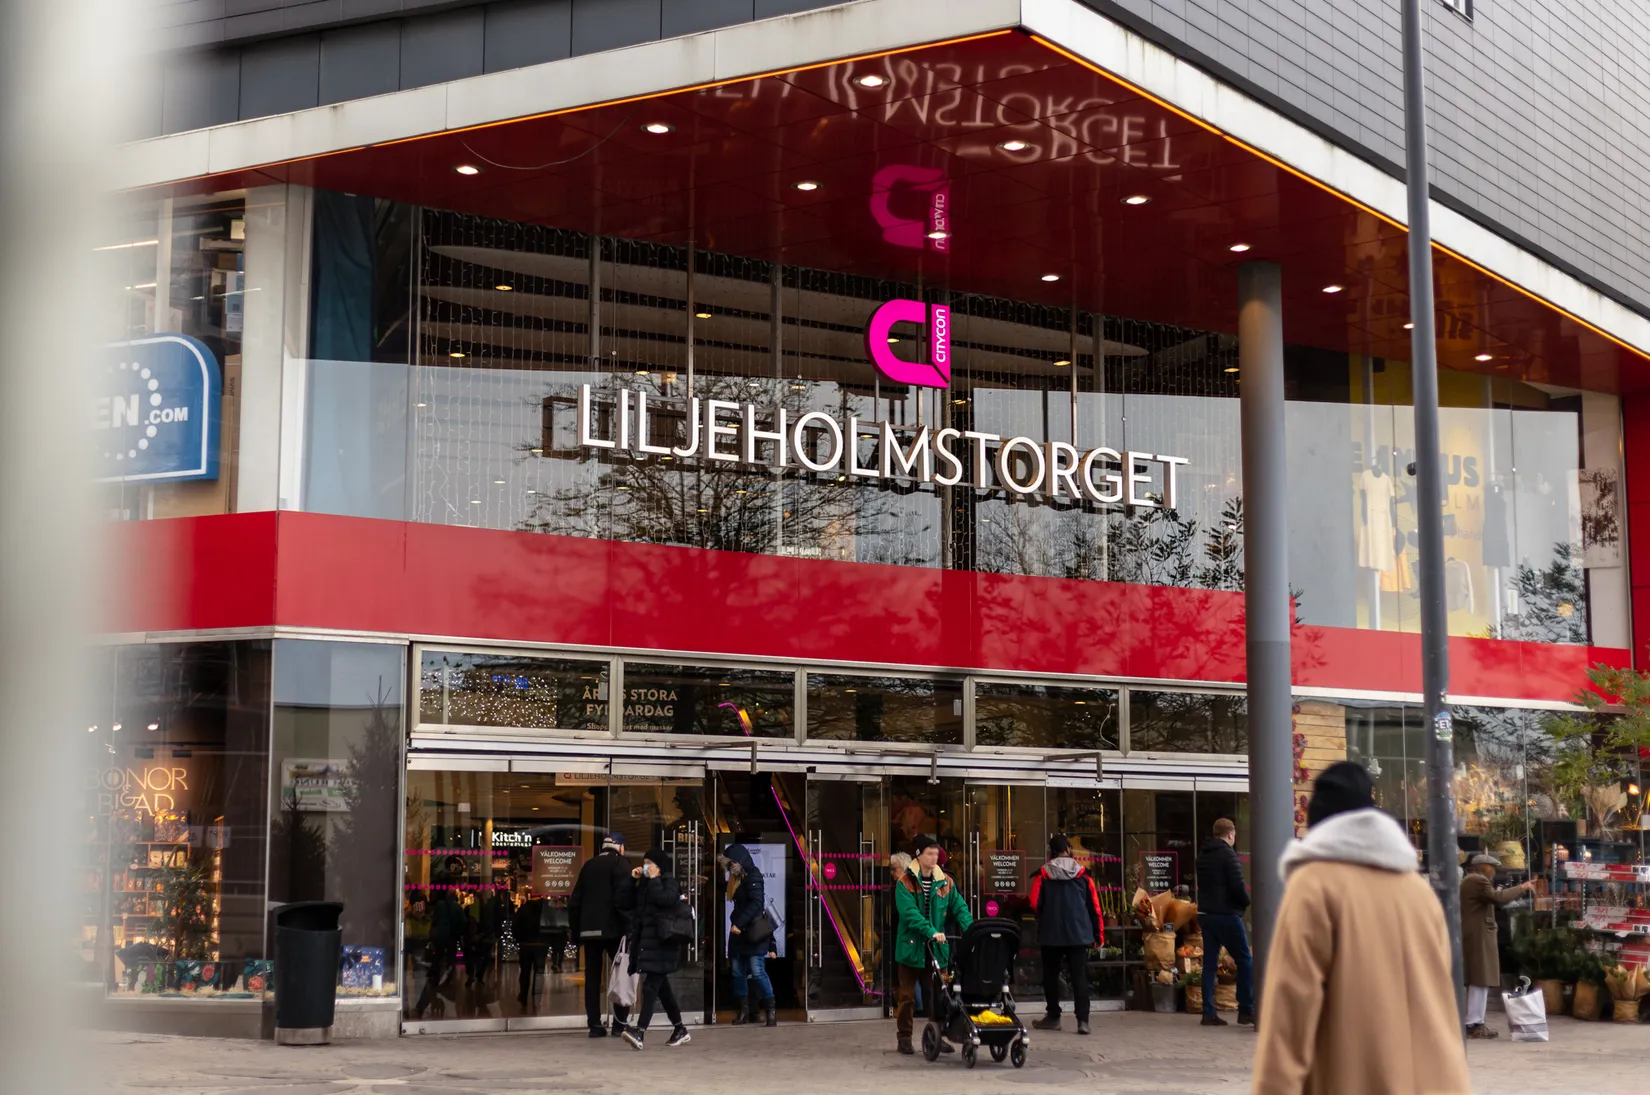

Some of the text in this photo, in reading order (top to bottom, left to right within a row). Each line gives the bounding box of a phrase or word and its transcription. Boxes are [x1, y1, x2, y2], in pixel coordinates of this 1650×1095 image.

[935, 308, 946, 363] CITYCON
[576, 384, 1191, 509] LILJEHOLMSTORGET
[630, 689, 678, 701] STORA
[586, 704, 674, 717] FYARDAG
[540, 850, 576, 858] VÄLKOMMEN
